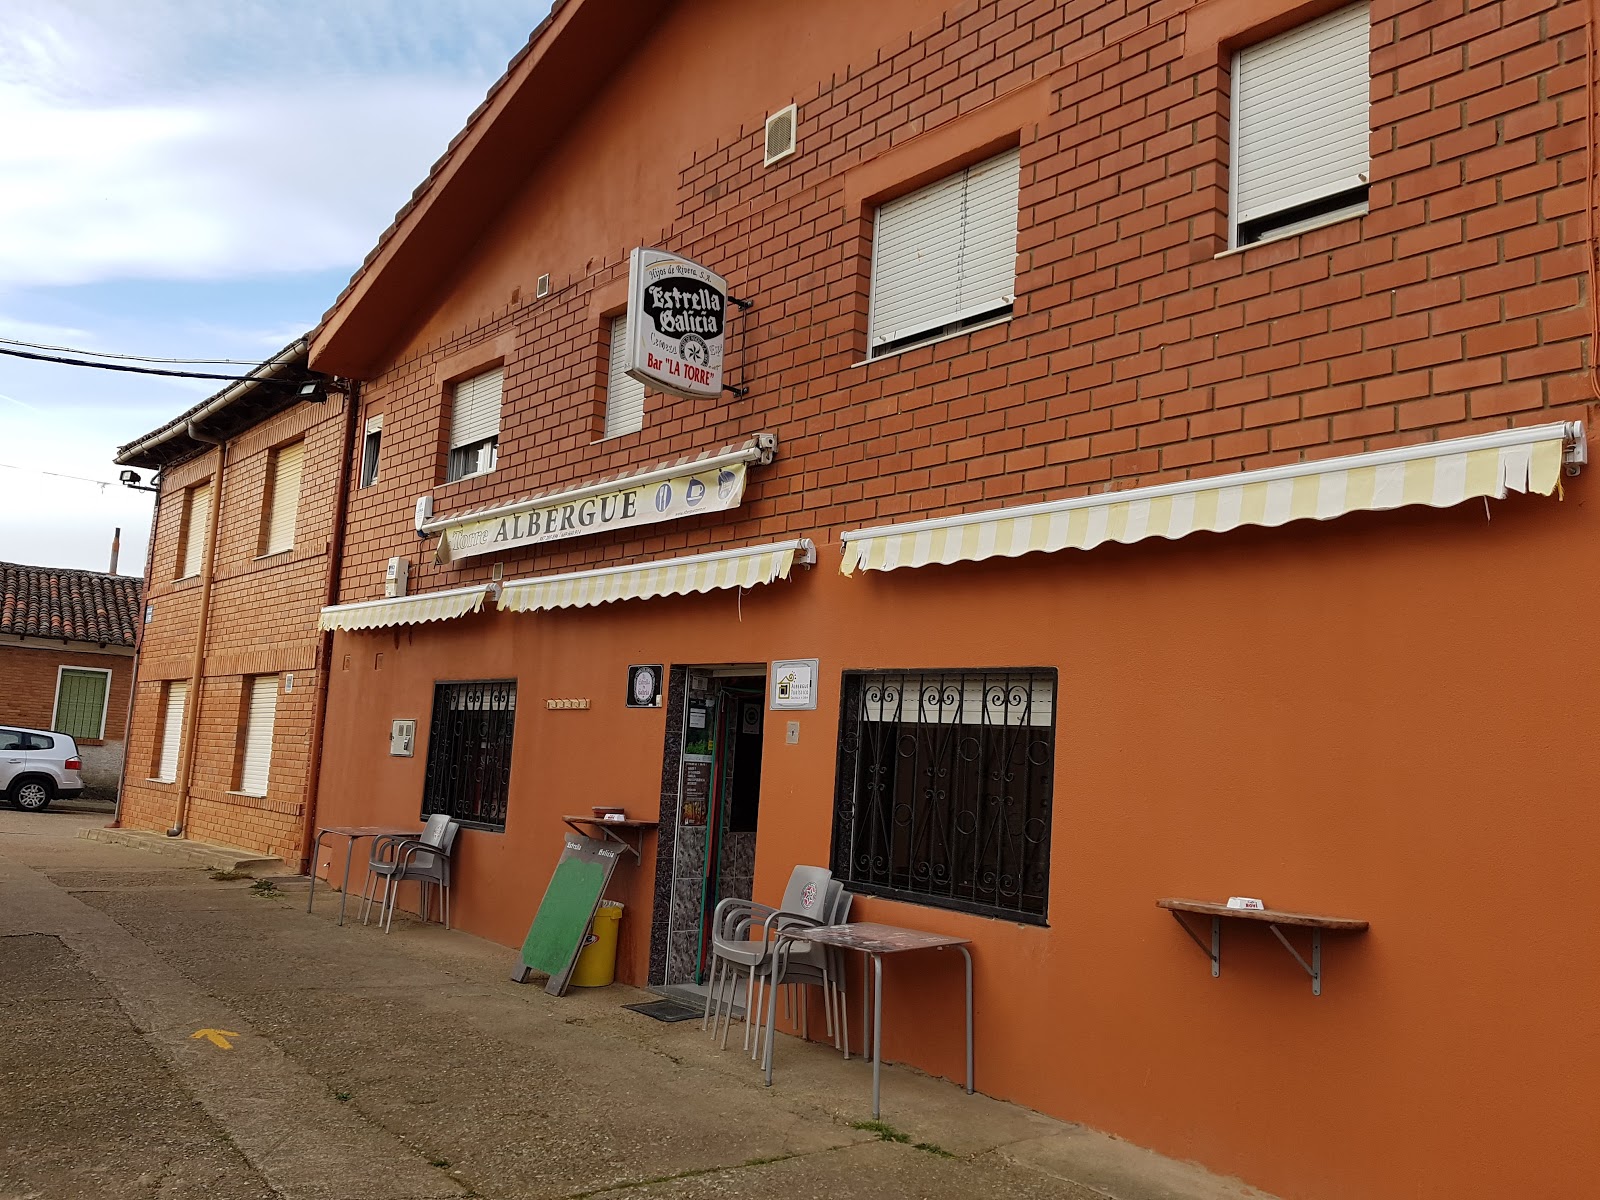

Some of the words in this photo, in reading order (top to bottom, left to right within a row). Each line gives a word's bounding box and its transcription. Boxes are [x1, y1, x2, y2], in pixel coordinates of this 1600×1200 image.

[649, 268, 667, 280] Hijos
[668, 264, 675, 275] de
[648, 285, 721, 312] Estrella
[659, 309, 718, 333] Galicia
[647, 352, 663, 371] Bar
[665, 357, 681, 377] "LA
[452, 529, 489, 551] Torre
[493, 490, 638, 543] ALBERGUE
